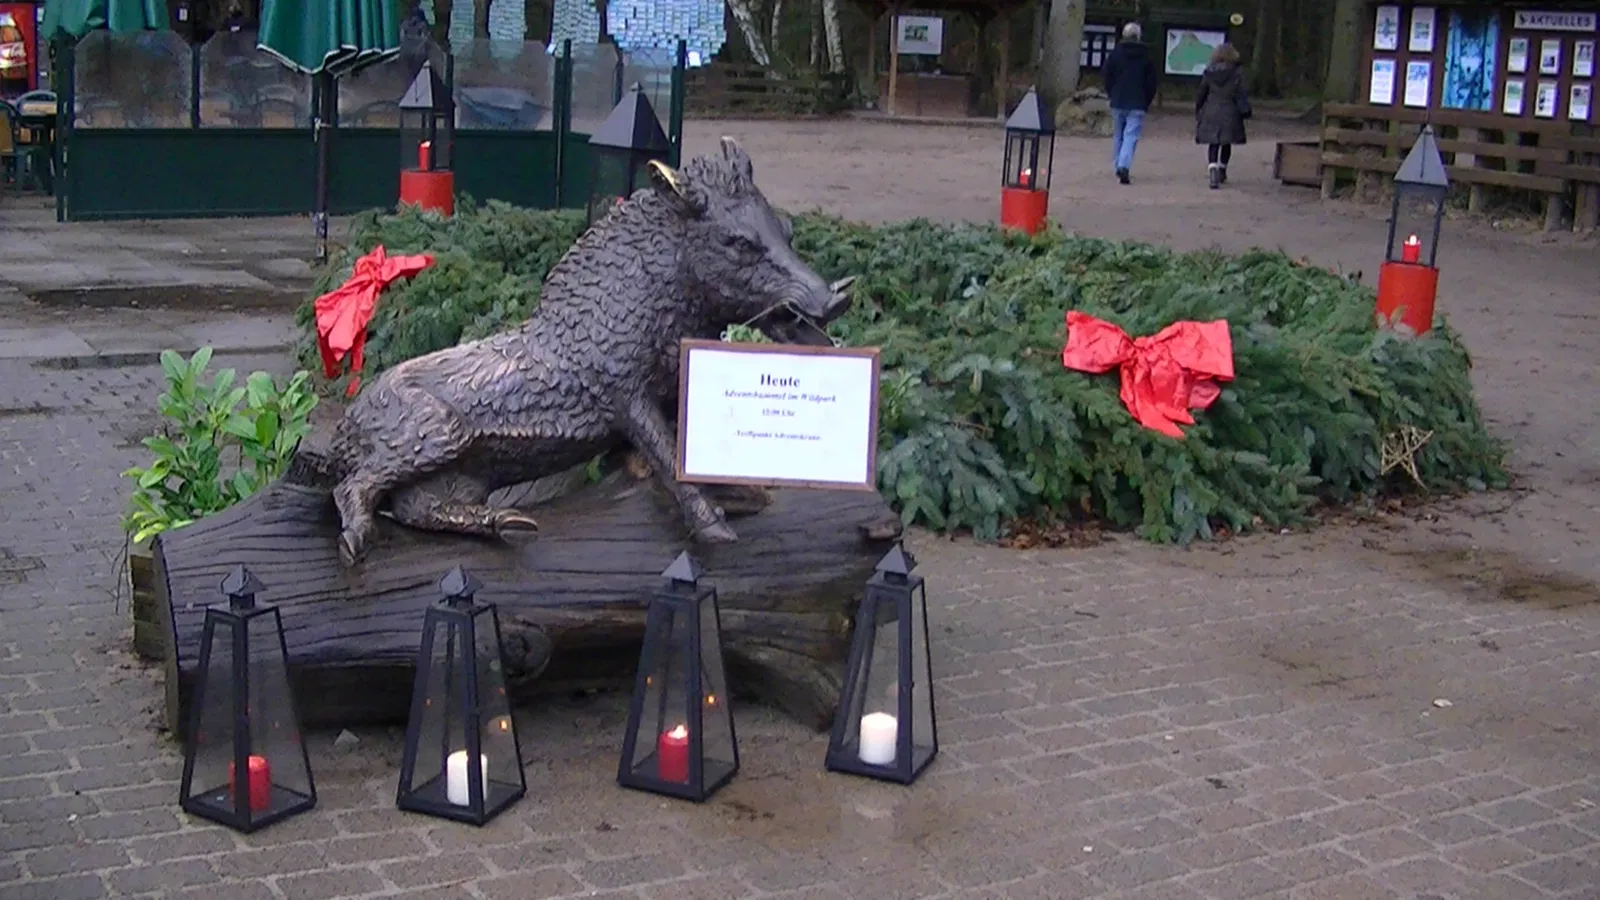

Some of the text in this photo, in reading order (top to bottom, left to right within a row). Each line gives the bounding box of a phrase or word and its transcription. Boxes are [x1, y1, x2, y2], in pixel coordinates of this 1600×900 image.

[1529, 15, 1591, 27] AKTUELLES
[760, 373, 800, 387] Heute
[787, 392, 798, 401] im
[801, 393, 836, 404] Wildpark
[782, 408, 796, 416] Uhr
